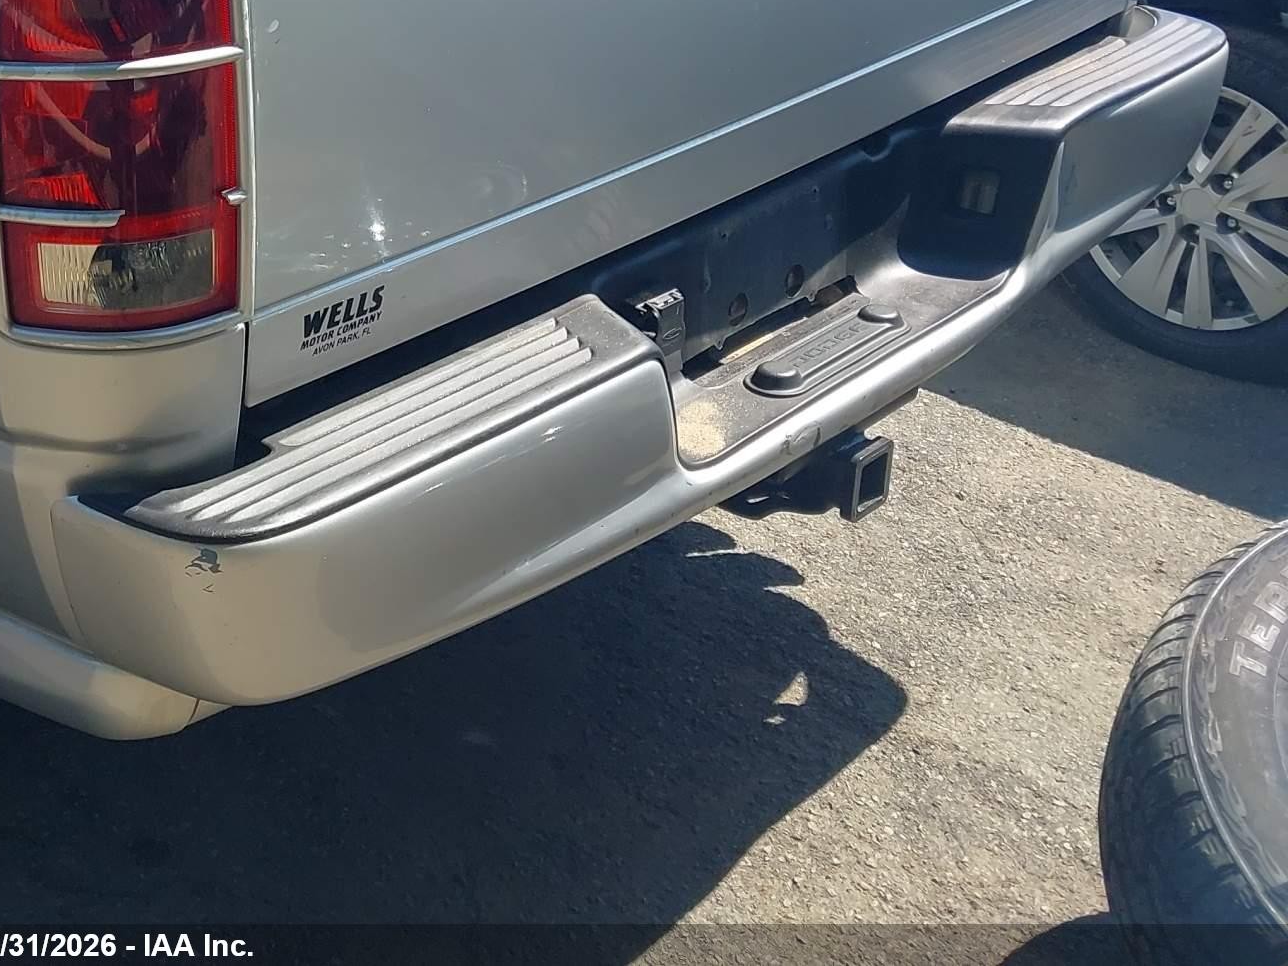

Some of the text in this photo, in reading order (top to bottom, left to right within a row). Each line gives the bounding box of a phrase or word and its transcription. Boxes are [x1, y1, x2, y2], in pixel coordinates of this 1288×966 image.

[300, 311, 383, 351] MOTOR COMPANY
[303, 285, 385, 338] WELLS
[312, 342, 335, 357] AVON
[362, 327, 372, 338] FL
[1229, 564, 1288, 677] TER
